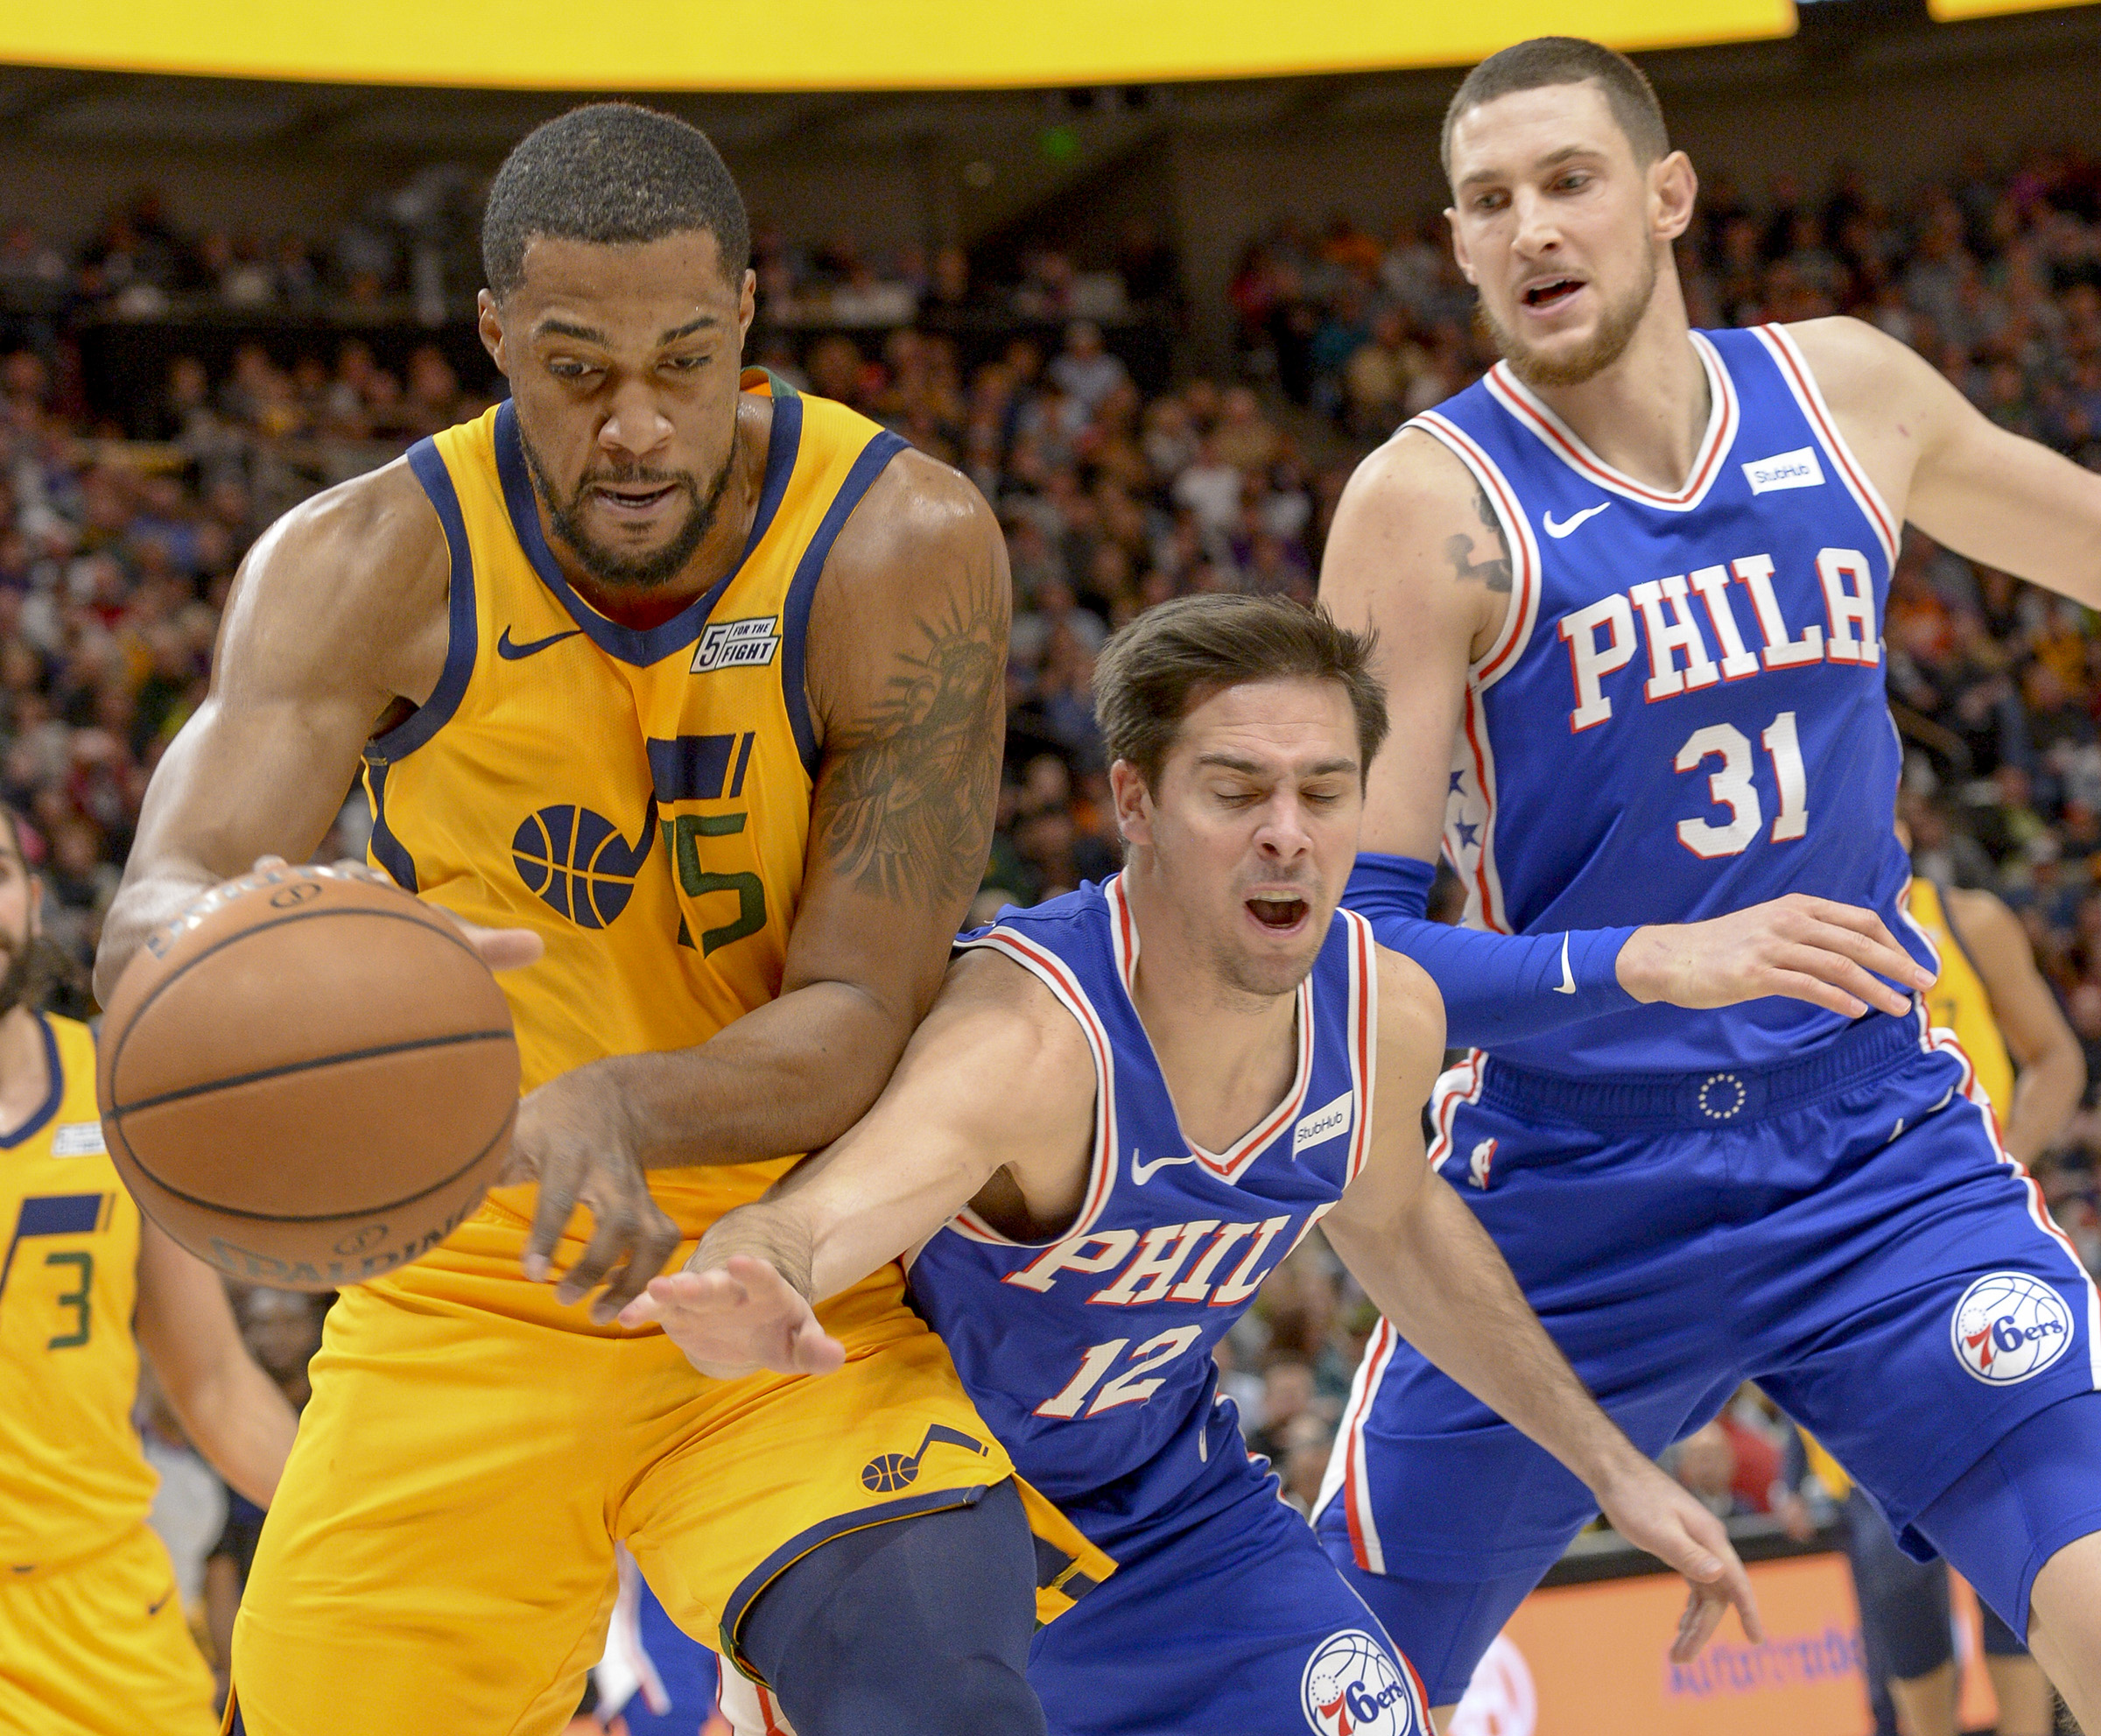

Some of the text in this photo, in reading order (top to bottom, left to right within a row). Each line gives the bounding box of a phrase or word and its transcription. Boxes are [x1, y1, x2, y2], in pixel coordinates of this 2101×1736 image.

[1754, 465, 1810, 483] StubHub
[699, 630, 726, 666] 5
[721, 643, 771, 663] FIGHT
[734, 622, 769, 636] FOR THE
[1557, 547, 1880, 734] PHILA
[1673, 711, 1809, 860] 31
[1297, 1111, 1343, 1143] StubHub
[46, 1250, 93, 1351] 3
[1965, 1315, 2063, 1371] 76ers
[1032, 1324, 1203, 1420] 12
[1318, 1679, 1404, 1736] 76ers
